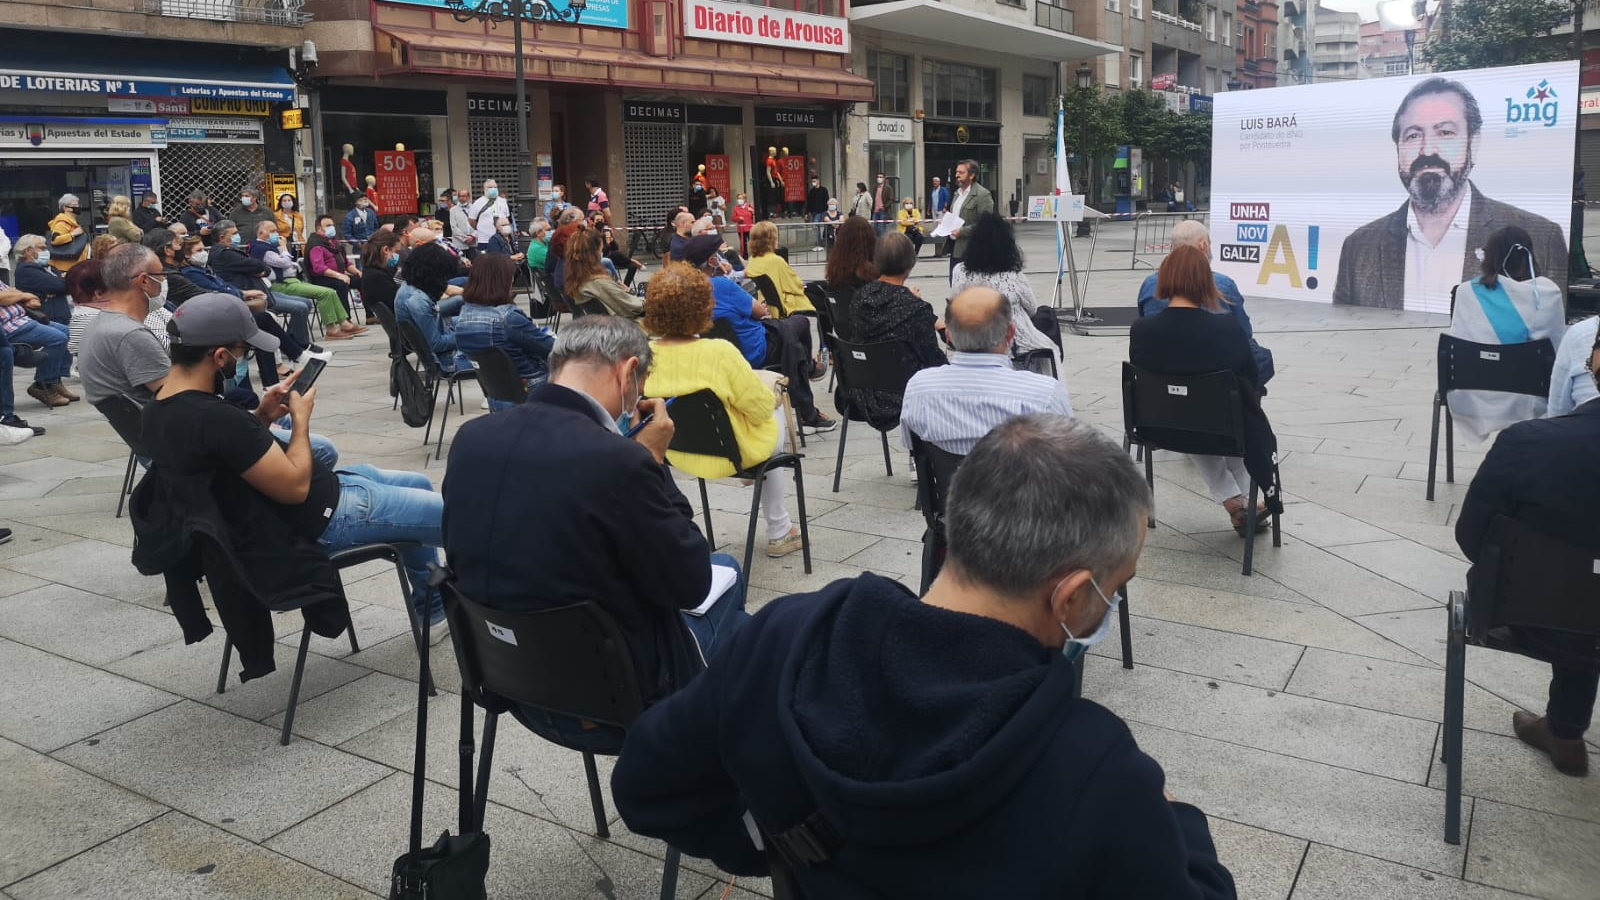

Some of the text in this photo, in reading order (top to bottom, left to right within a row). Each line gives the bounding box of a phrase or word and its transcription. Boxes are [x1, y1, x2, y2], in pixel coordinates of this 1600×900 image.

[694, 5, 843, 46] Diario de Arousa
[1, 76, 21, 88] DE
[27, 77, 101, 92] LOTERIAS
[128, 82, 137, 94] 1
[182, 86, 211, 95] Loterias
[219, 88, 249, 98] Apuestas
[158, 102, 187, 112] Santi
[630, 106, 680, 118] DECIMAS
[1505, 98, 1558, 127] bng
[776, 113, 815, 123] DECIMAS
[1240, 113, 1297, 130] LUIS BARÁ
[18, 131, 25, 140] y
[47, 129, 88, 139] Apuestas
[94, 129, 108, 138] del
[111, 130, 142, 138] Estado
[169, 128, 203, 136] ENDE
[1232, 205, 1267, 218] UNHA
[1239, 227, 1265, 240] NOV
[1222, 247, 1257, 260] GALIZ
